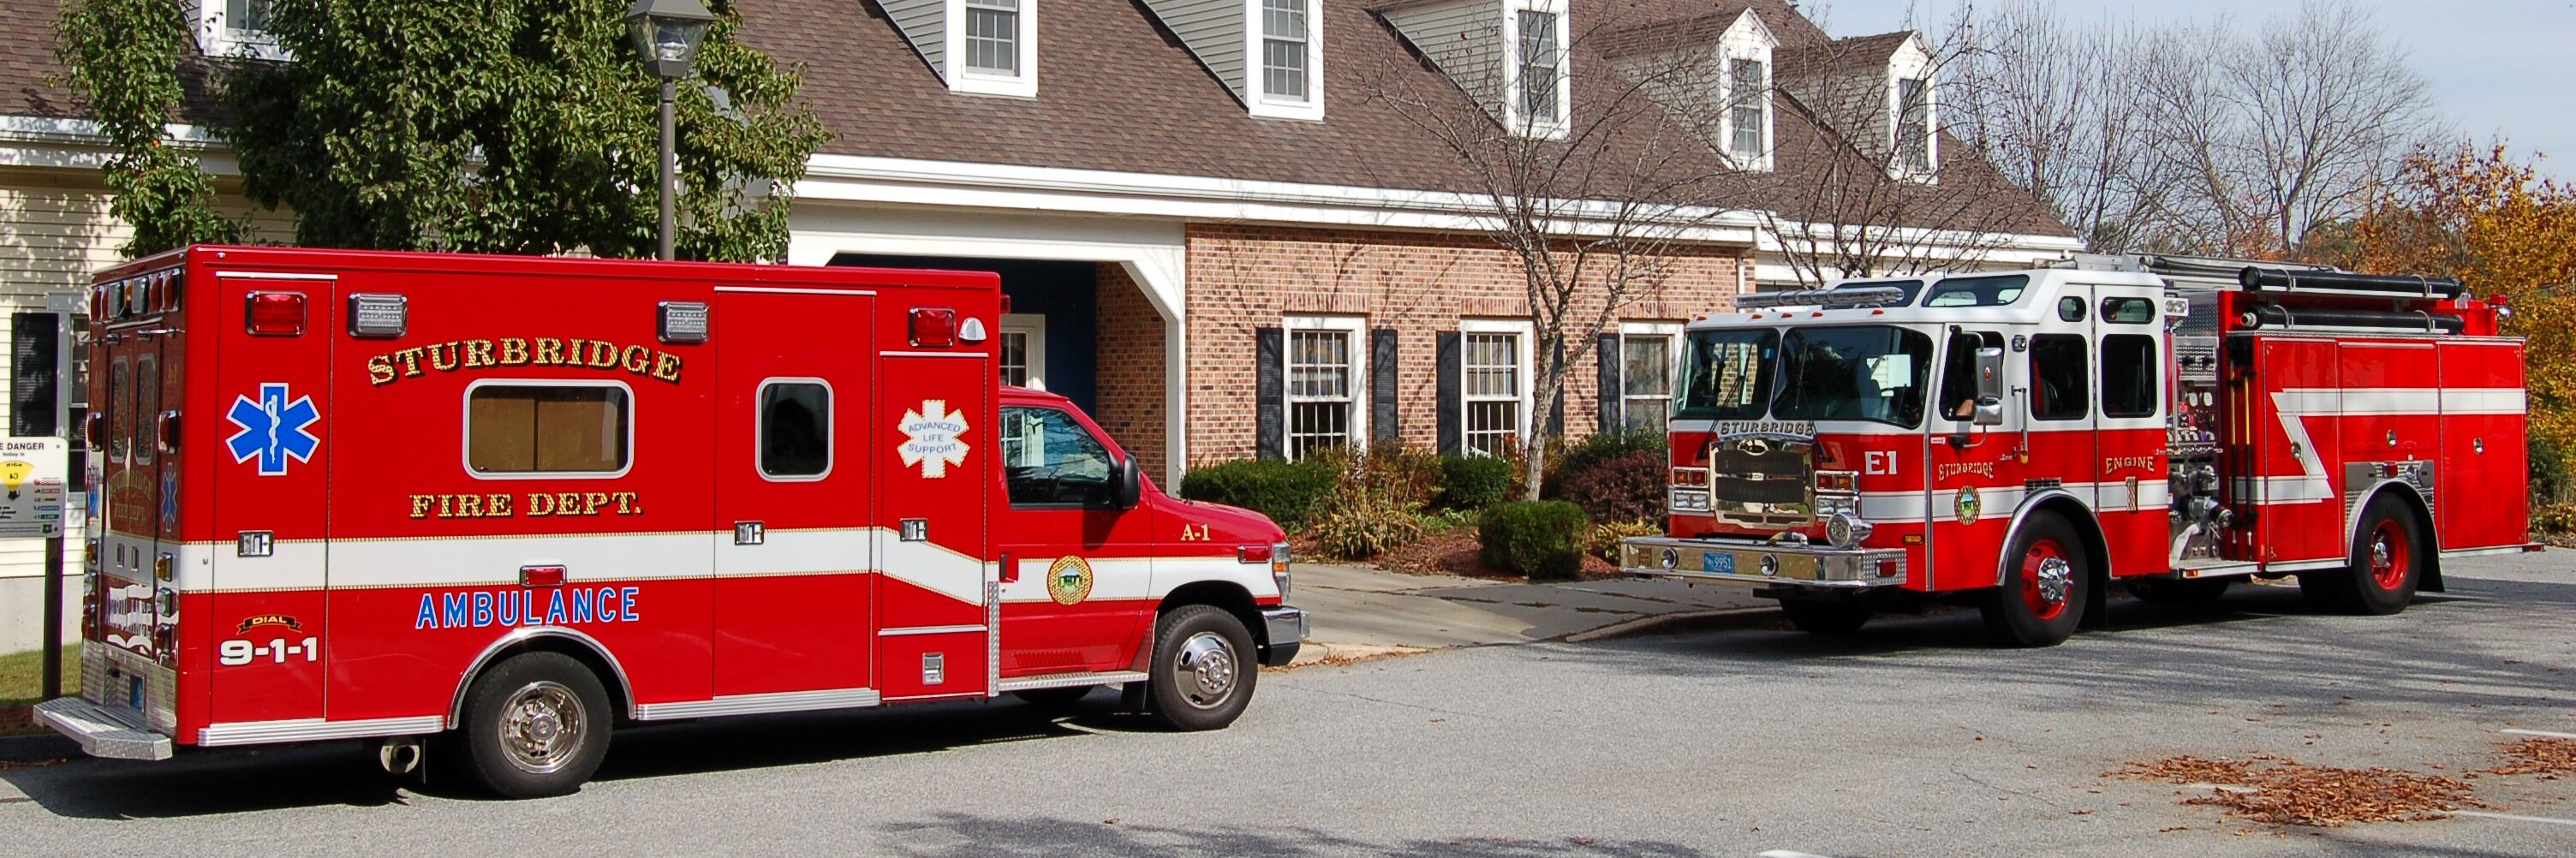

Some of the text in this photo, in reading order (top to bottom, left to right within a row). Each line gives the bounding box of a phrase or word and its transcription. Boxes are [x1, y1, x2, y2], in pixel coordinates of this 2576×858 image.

[367, 337, 684, 385] STURBRIDGE
[909, 421, 961, 432] ADVANCED
[1720, 420, 1814, 437] STURBRIDGE
[7, 442, 45, 450] DANGER
[908, 443, 957, 454] SUPPORT
[1864, 450, 1898, 475] E1
[1938, 462, 1994, 481] STURBRIDGE
[2105, 456, 2155, 475] ENGINE
[409, 492, 645, 519] FIRE DEPT.
[1180, 523, 1211, 541] A-1
[415, 587, 639, 629] AMBULANCE
[252, 616, 288, 625] DIAL
[219, 636, 318, 665] 9-1-1
